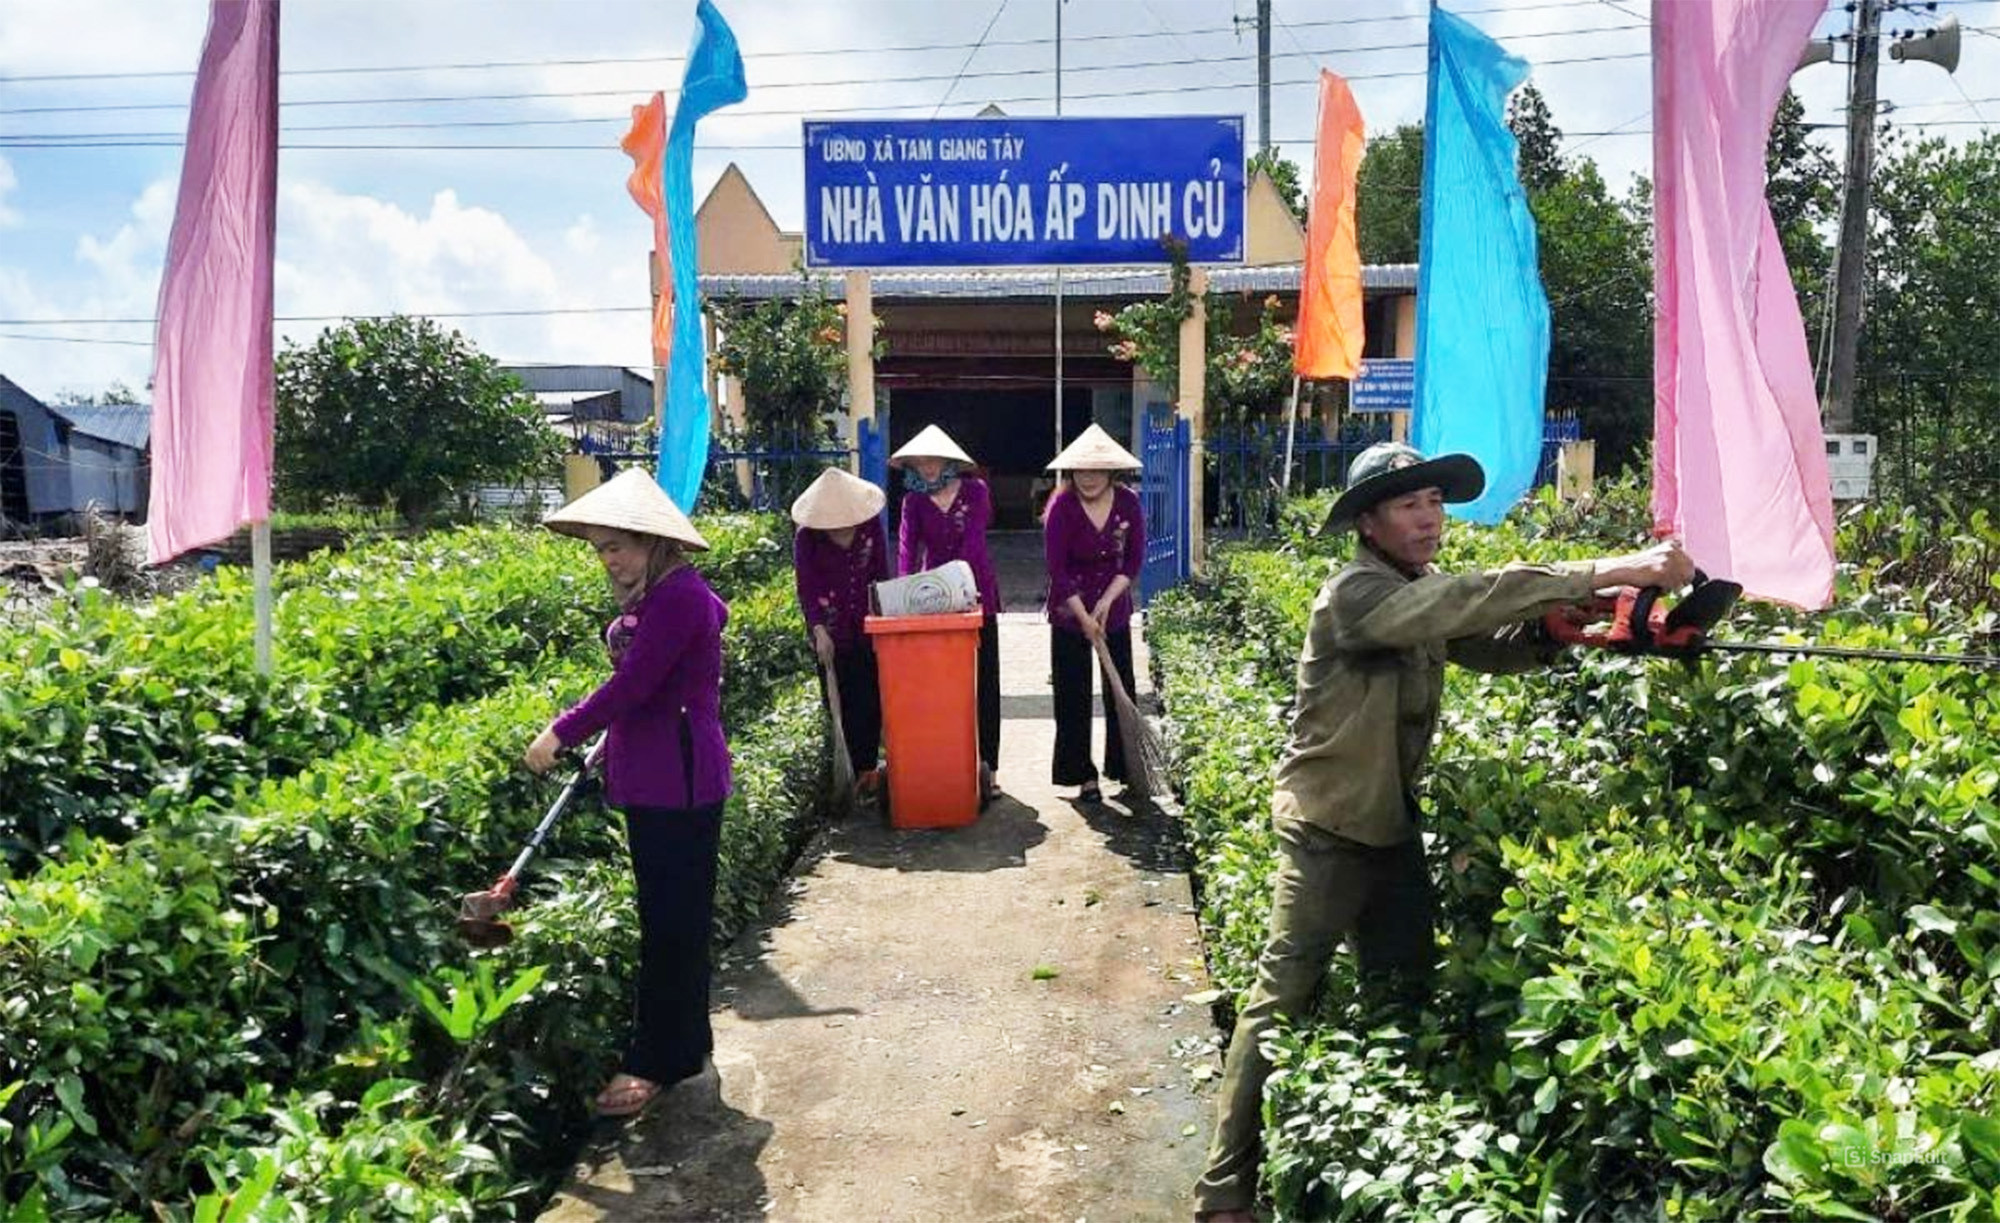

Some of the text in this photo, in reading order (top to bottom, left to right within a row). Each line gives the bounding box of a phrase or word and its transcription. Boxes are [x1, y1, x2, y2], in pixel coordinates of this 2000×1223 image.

[823, 133, 1025, 162] UBND XÃ TAM GIANG TÂY
[820, 157, 1226, 244] NHÀ VĂN HÓA ẤP DINH CỦ
